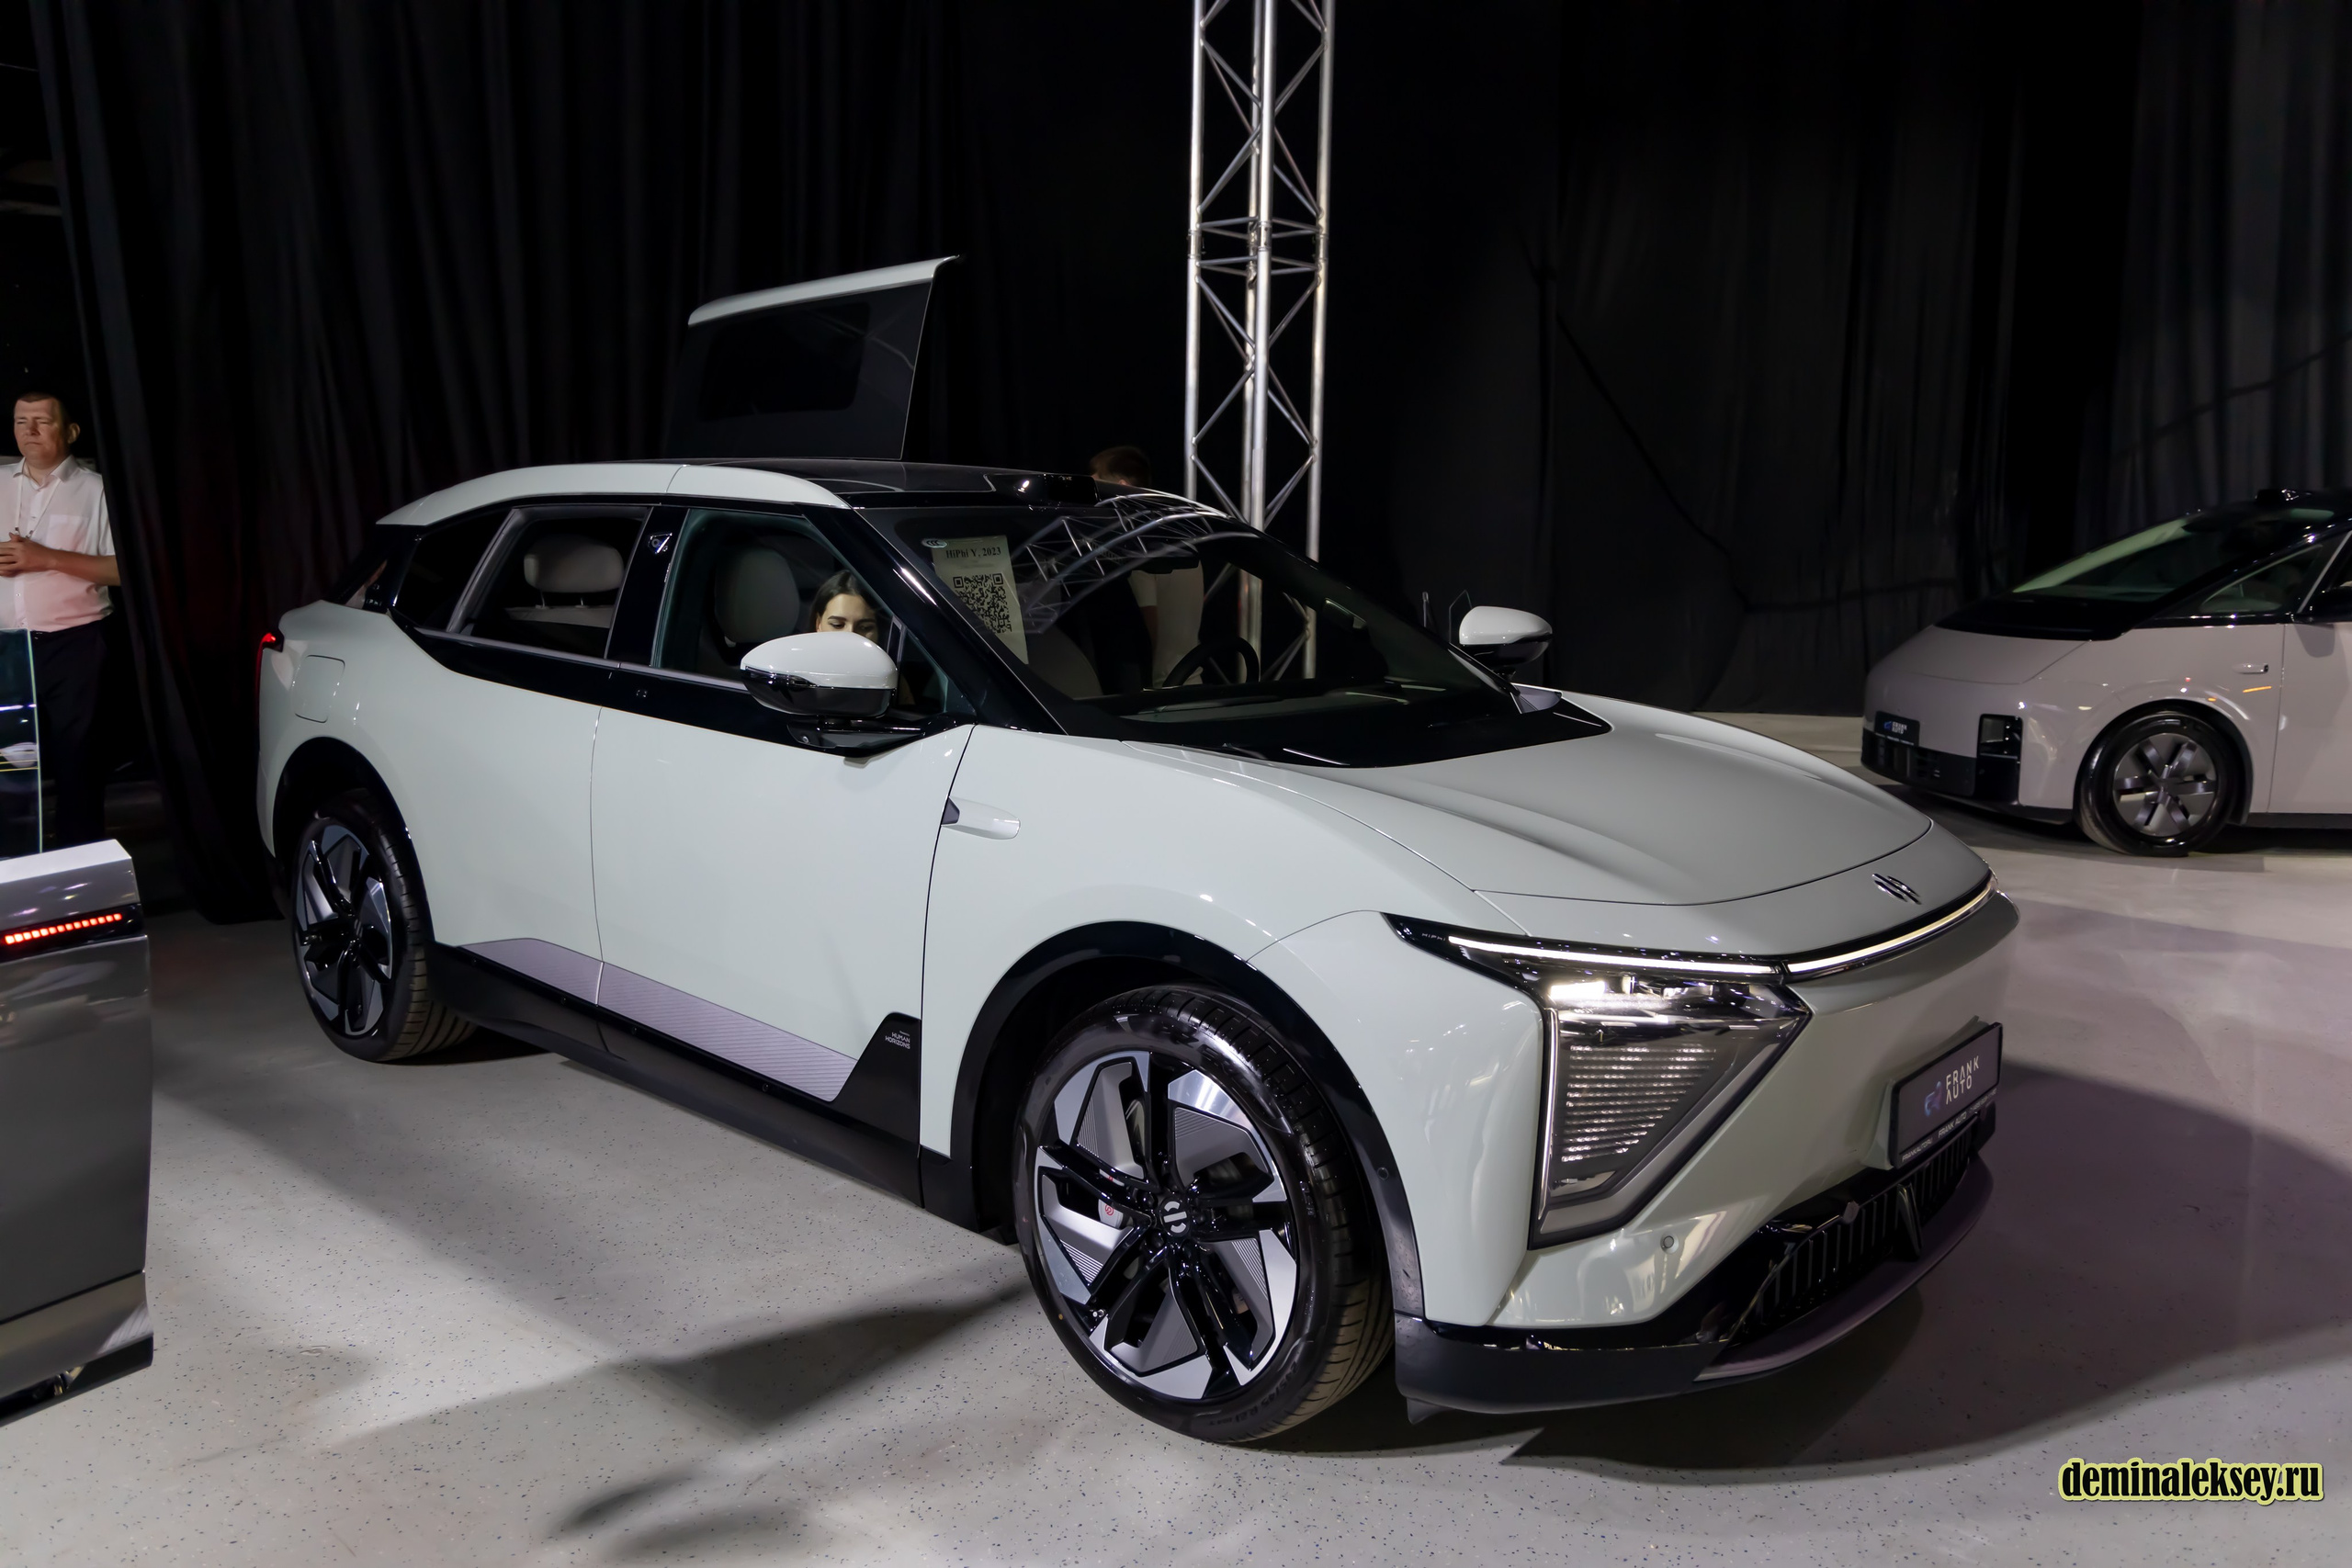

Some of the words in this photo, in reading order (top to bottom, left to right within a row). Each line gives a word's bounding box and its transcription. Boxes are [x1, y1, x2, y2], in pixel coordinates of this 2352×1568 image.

[945, 548, 969, 558] HiPhi
[982, 547, 1001, 557] 2023
[885, 1035, 911, 1050] HORIZONS
[891, 1032, 910, 1043] HUMAN
[1946, 1055, 1980, 1090] FRANK
[1945, 1075, 1973, 1105] AUTO
